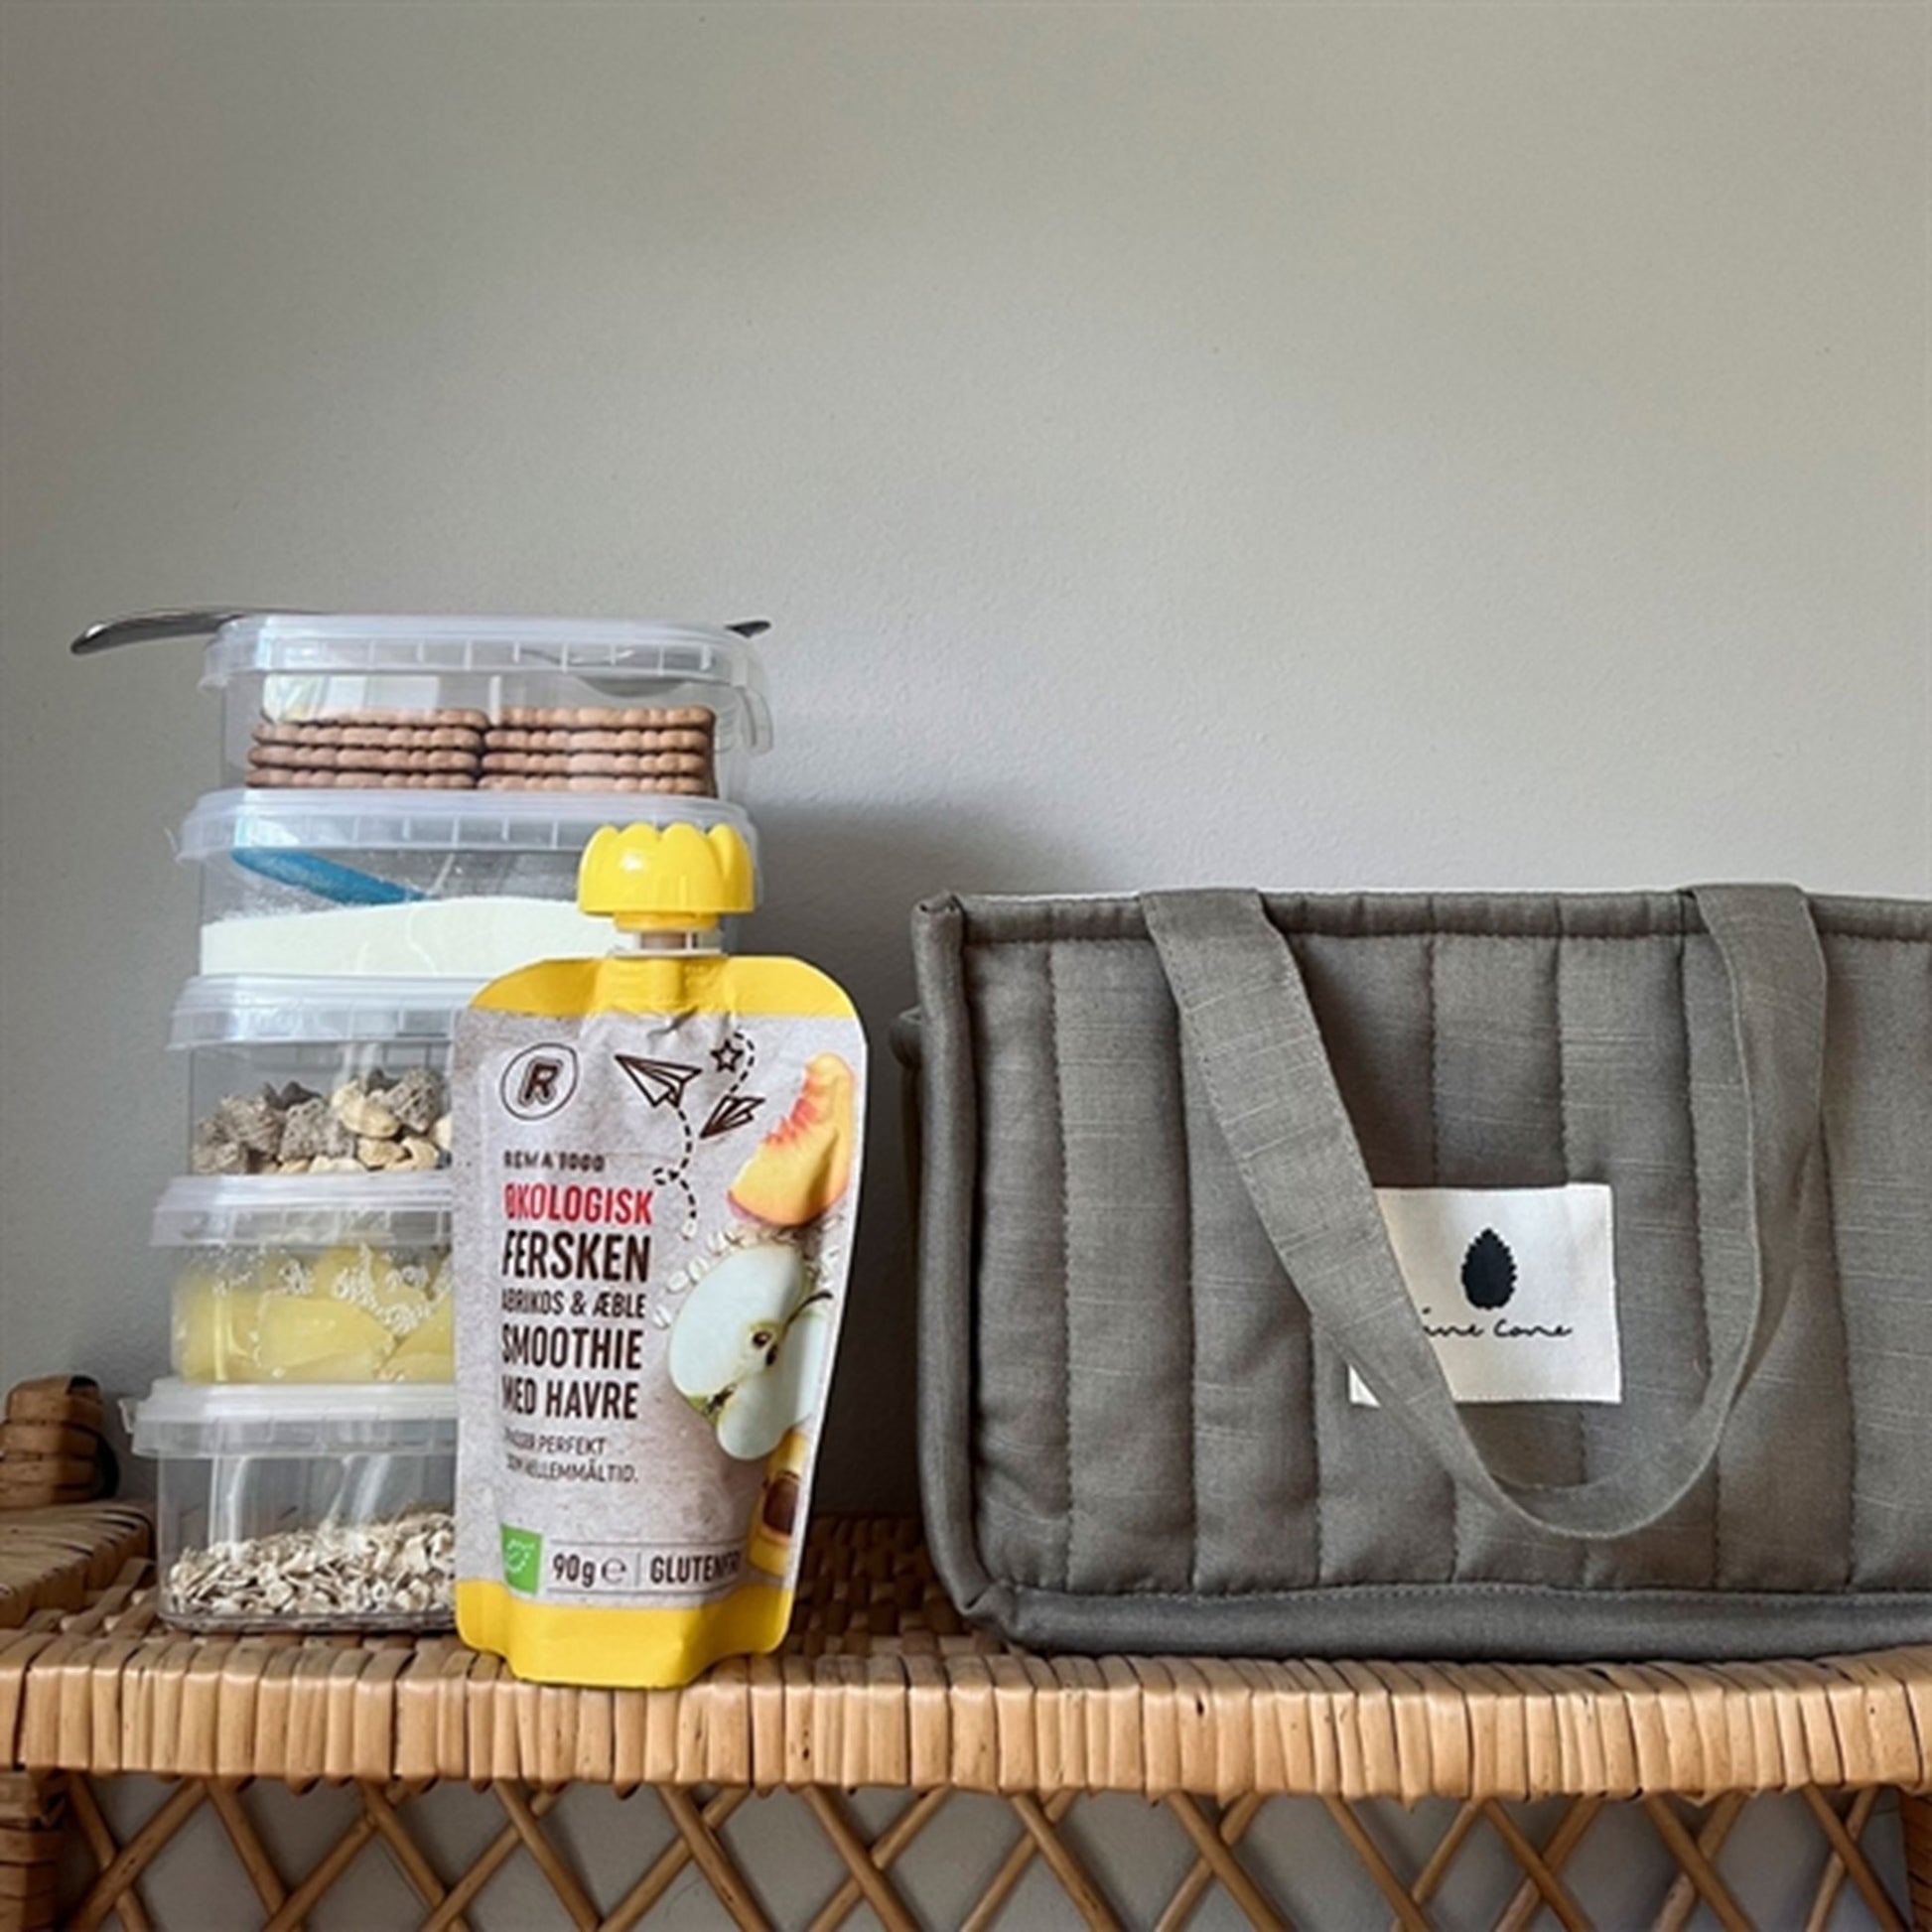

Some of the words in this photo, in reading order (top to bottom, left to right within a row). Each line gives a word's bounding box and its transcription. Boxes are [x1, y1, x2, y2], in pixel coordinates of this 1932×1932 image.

[504, 1182, 653, 1225] ØKOLOGISK
[501, 1229, 650, 1283] FERSKEN
[570, 1290, 587, 1315] &
[592, 1292, 646, 1318] ÆBLE
[1422, 1309, 1484, 1337] ine
[1493, 1318, 1573, 1337] Cone
[501, 1322, 643, 1370] SMOOTHIE
[546, 1379, 639, 1420] HAVRE
[552, 1553, 595, 1587] 90g
